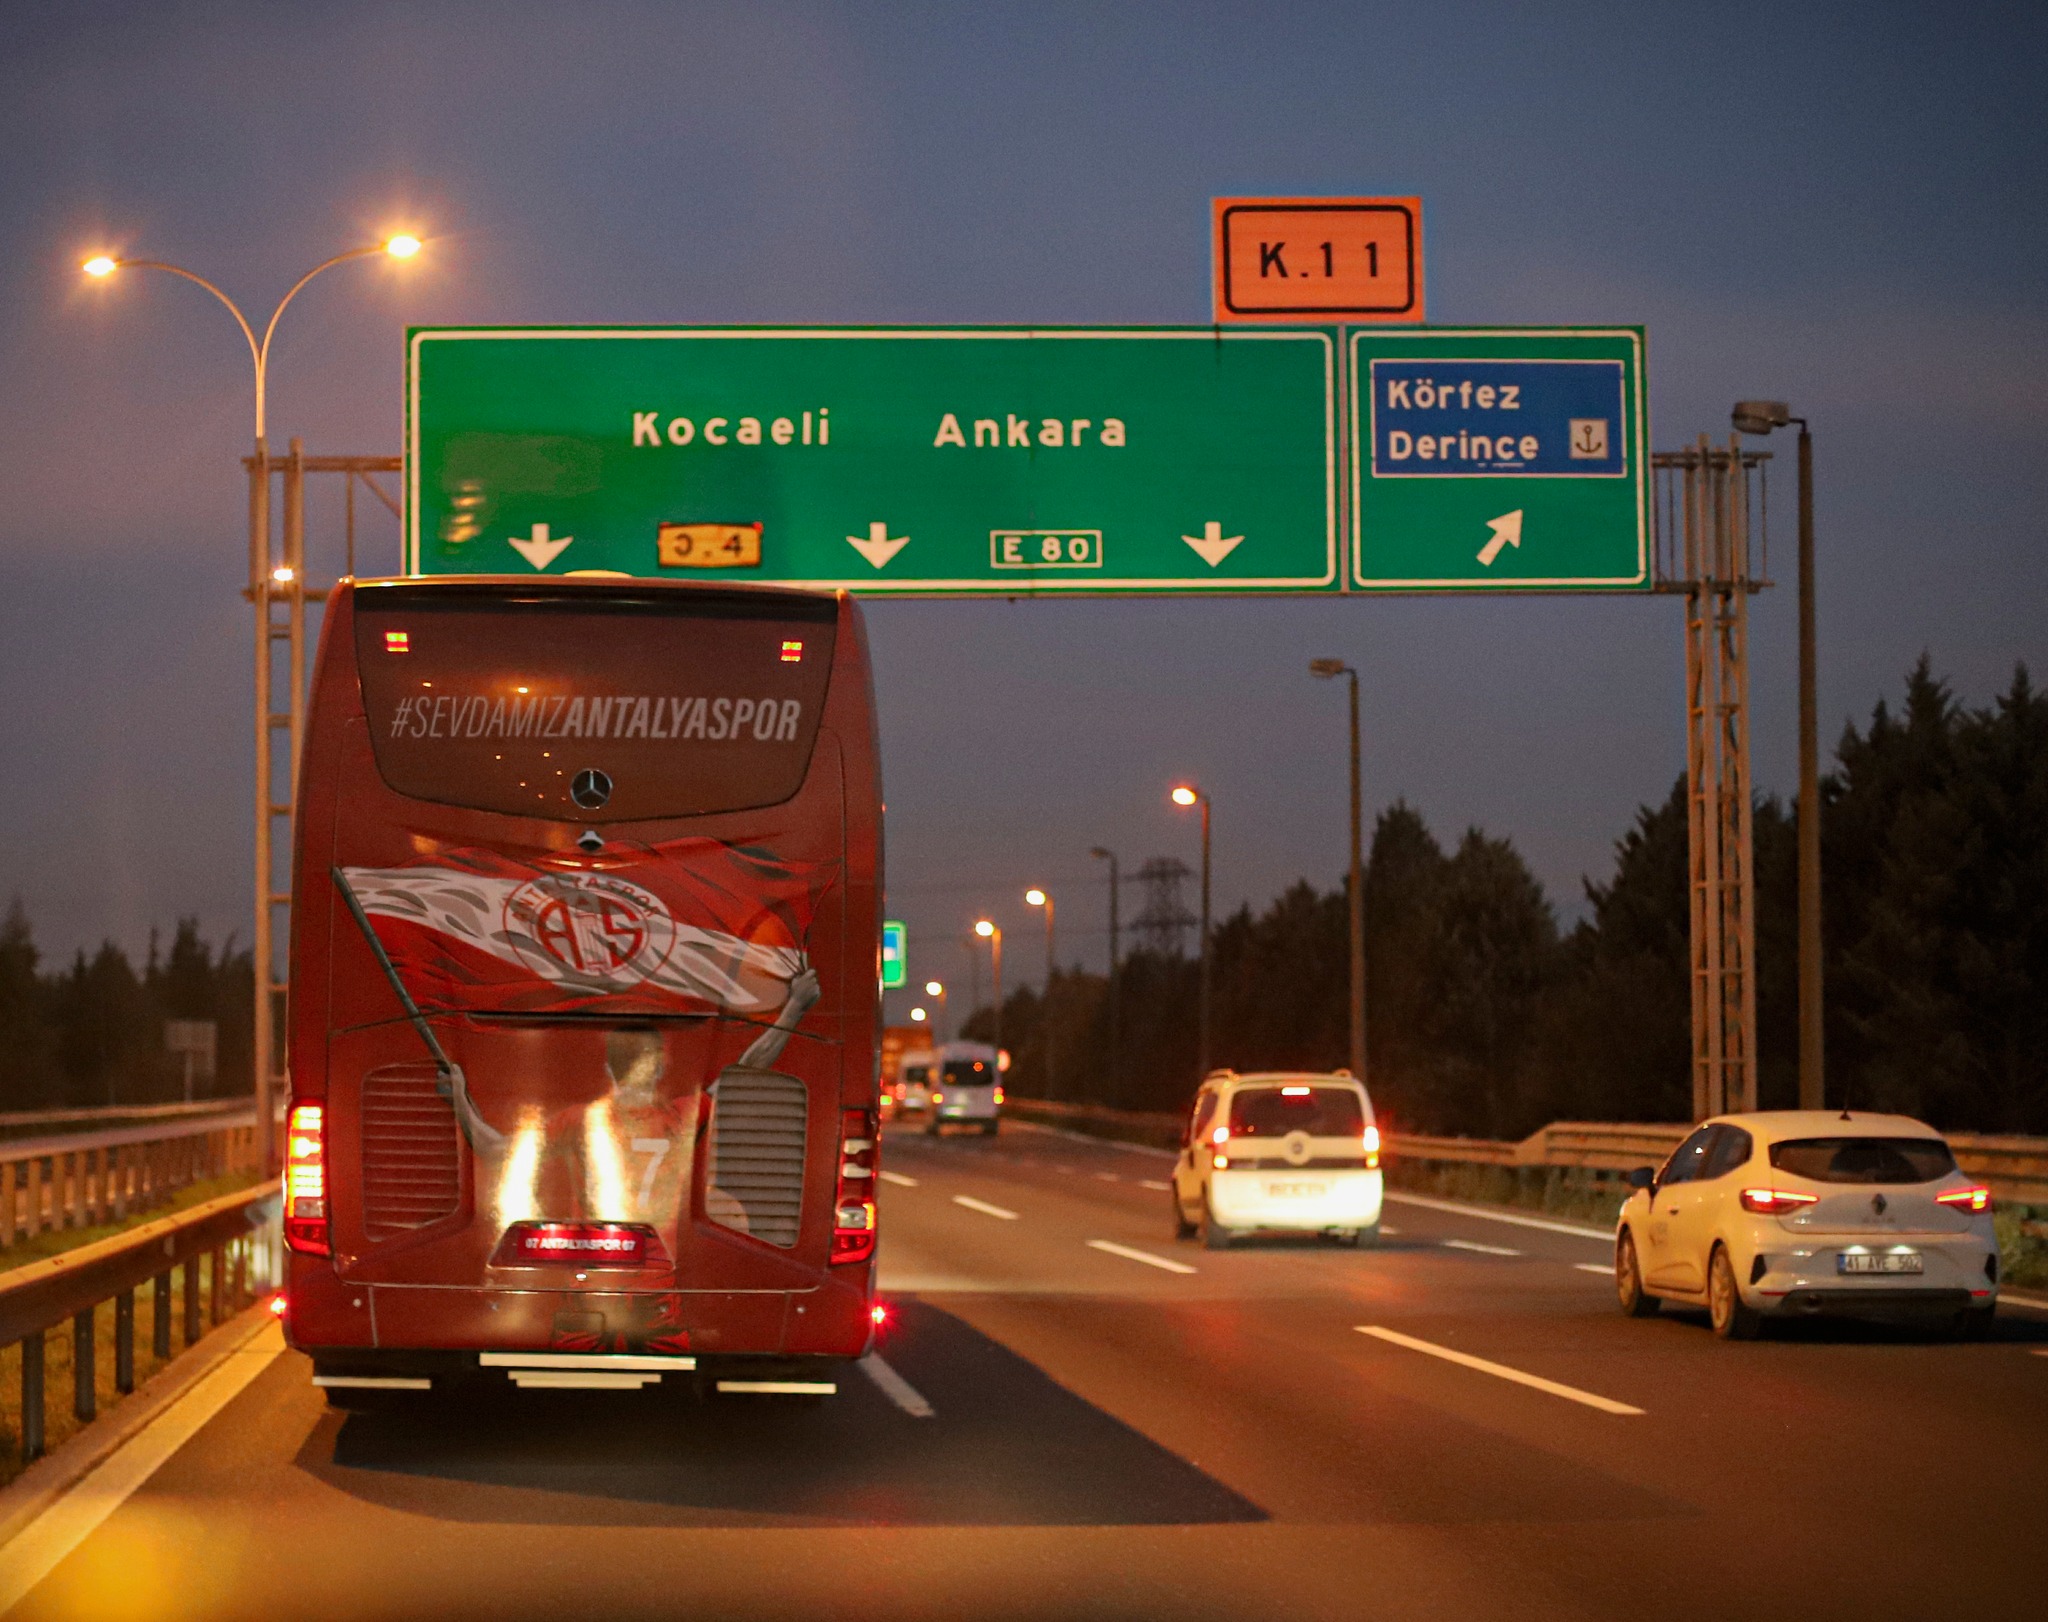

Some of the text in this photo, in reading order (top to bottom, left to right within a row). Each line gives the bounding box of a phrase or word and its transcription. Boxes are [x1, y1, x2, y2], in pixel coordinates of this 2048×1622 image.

[1387, 378, 1521, 410] Körfez
[632, 407, 1126, 448] Kocaeli Ankara
[1388, 429, 1540, 461] Derince
[1003, 536, 1090, 562] E 80
[630, 1138, 671, 1209] 7
